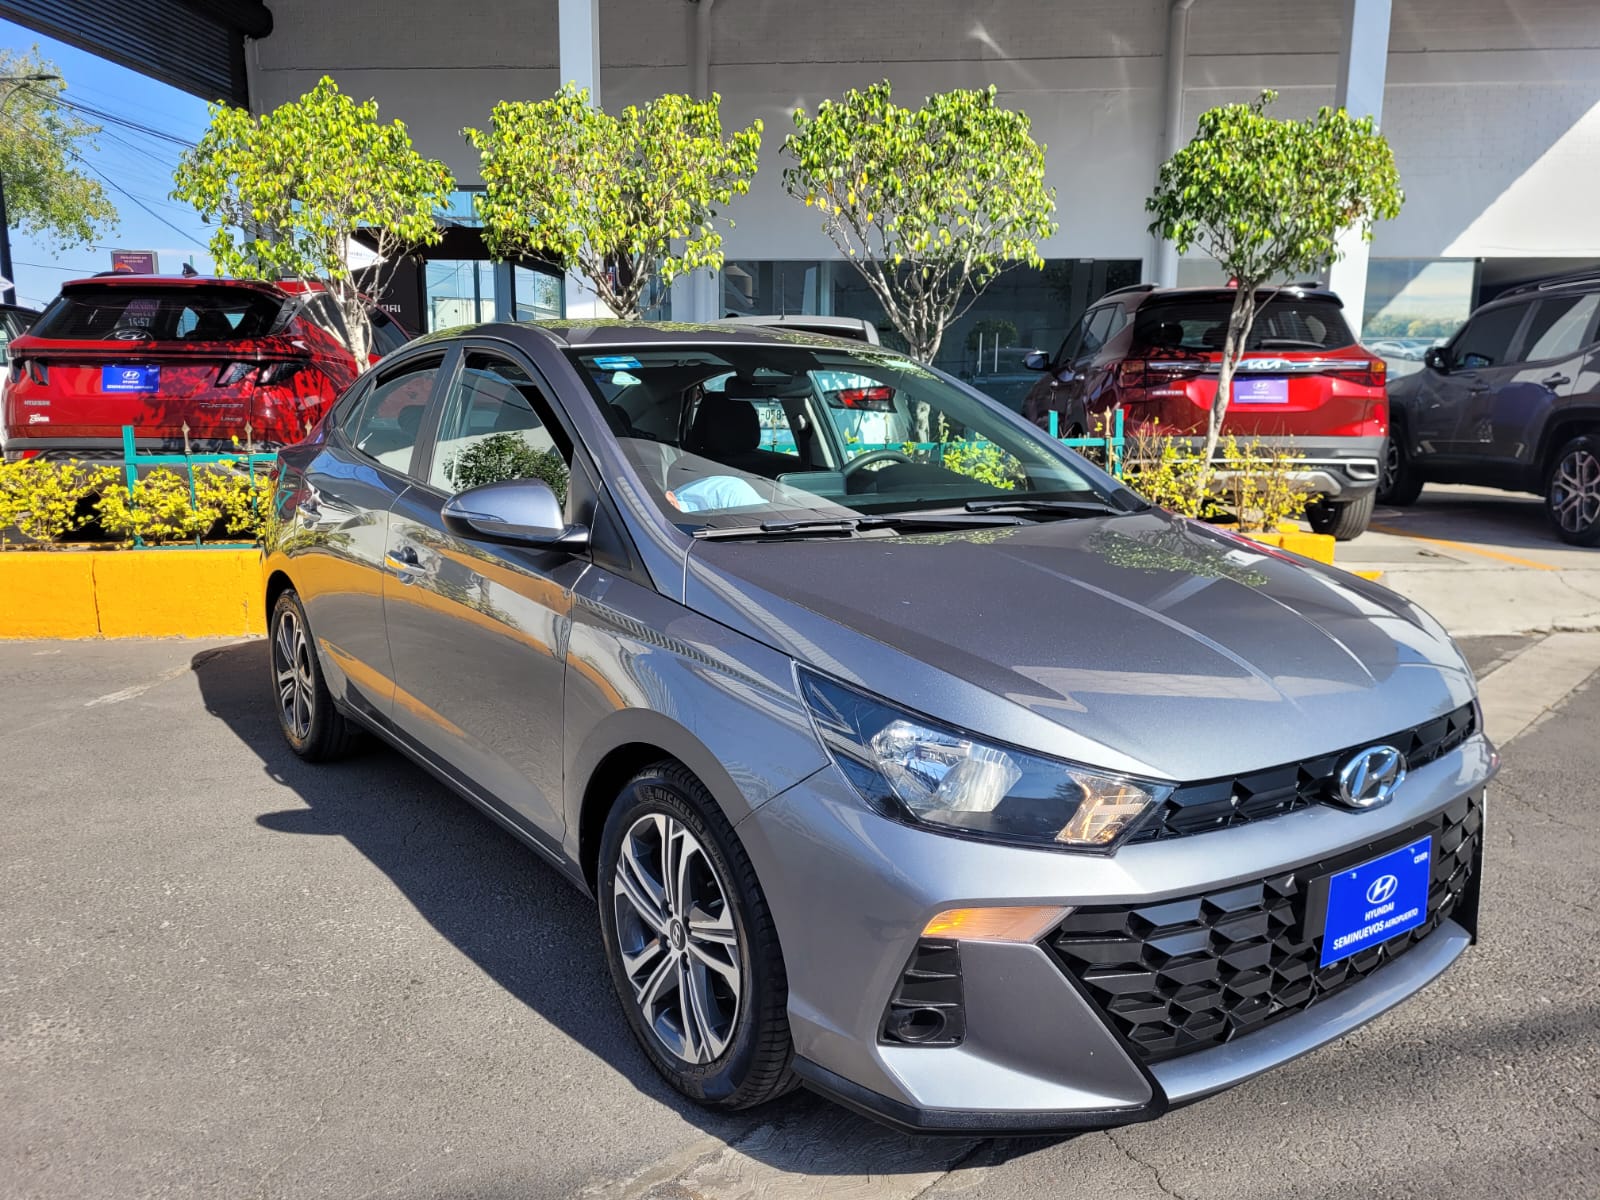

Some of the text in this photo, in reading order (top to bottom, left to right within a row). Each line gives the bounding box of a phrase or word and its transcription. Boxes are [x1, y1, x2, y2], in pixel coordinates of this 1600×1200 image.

[654, 786, 704, 834] MICHELIN
[1333, 907, 1419, 950] SEMINUEVOS AEROPUERTO
[1365, 901, 1395, 921] HYUNDAI
